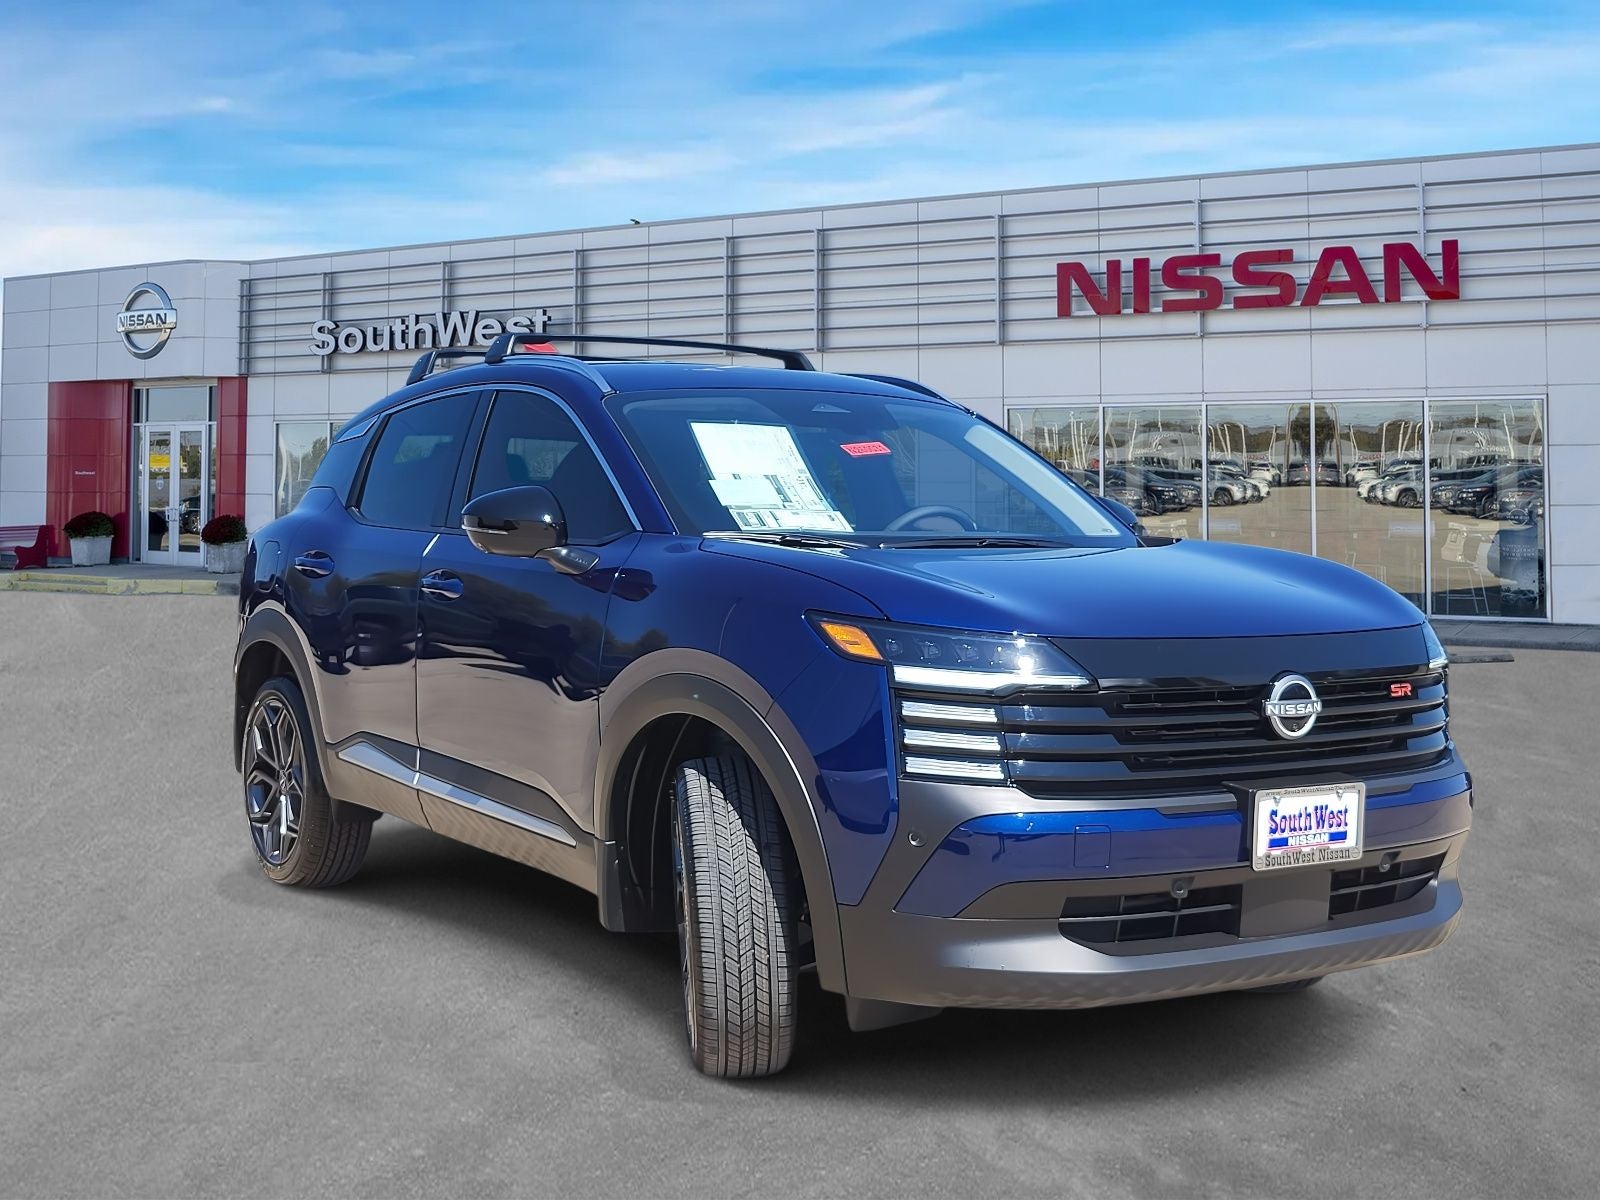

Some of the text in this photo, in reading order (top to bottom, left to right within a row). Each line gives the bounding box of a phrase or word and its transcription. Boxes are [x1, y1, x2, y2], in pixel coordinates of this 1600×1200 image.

[1056, 239, 1461, 318] NISSAN
[119, 312, 167, 328] NISSAN
[308, 308, 551, 356] SouthWest
[1390, 683, 1412, 697] SR
[1266, 702, 1322, 715] NISSAN
[1287, 832, 1329, 847] NISSAN
[1264, 847, 1351, 867] SouthWest Nissan
